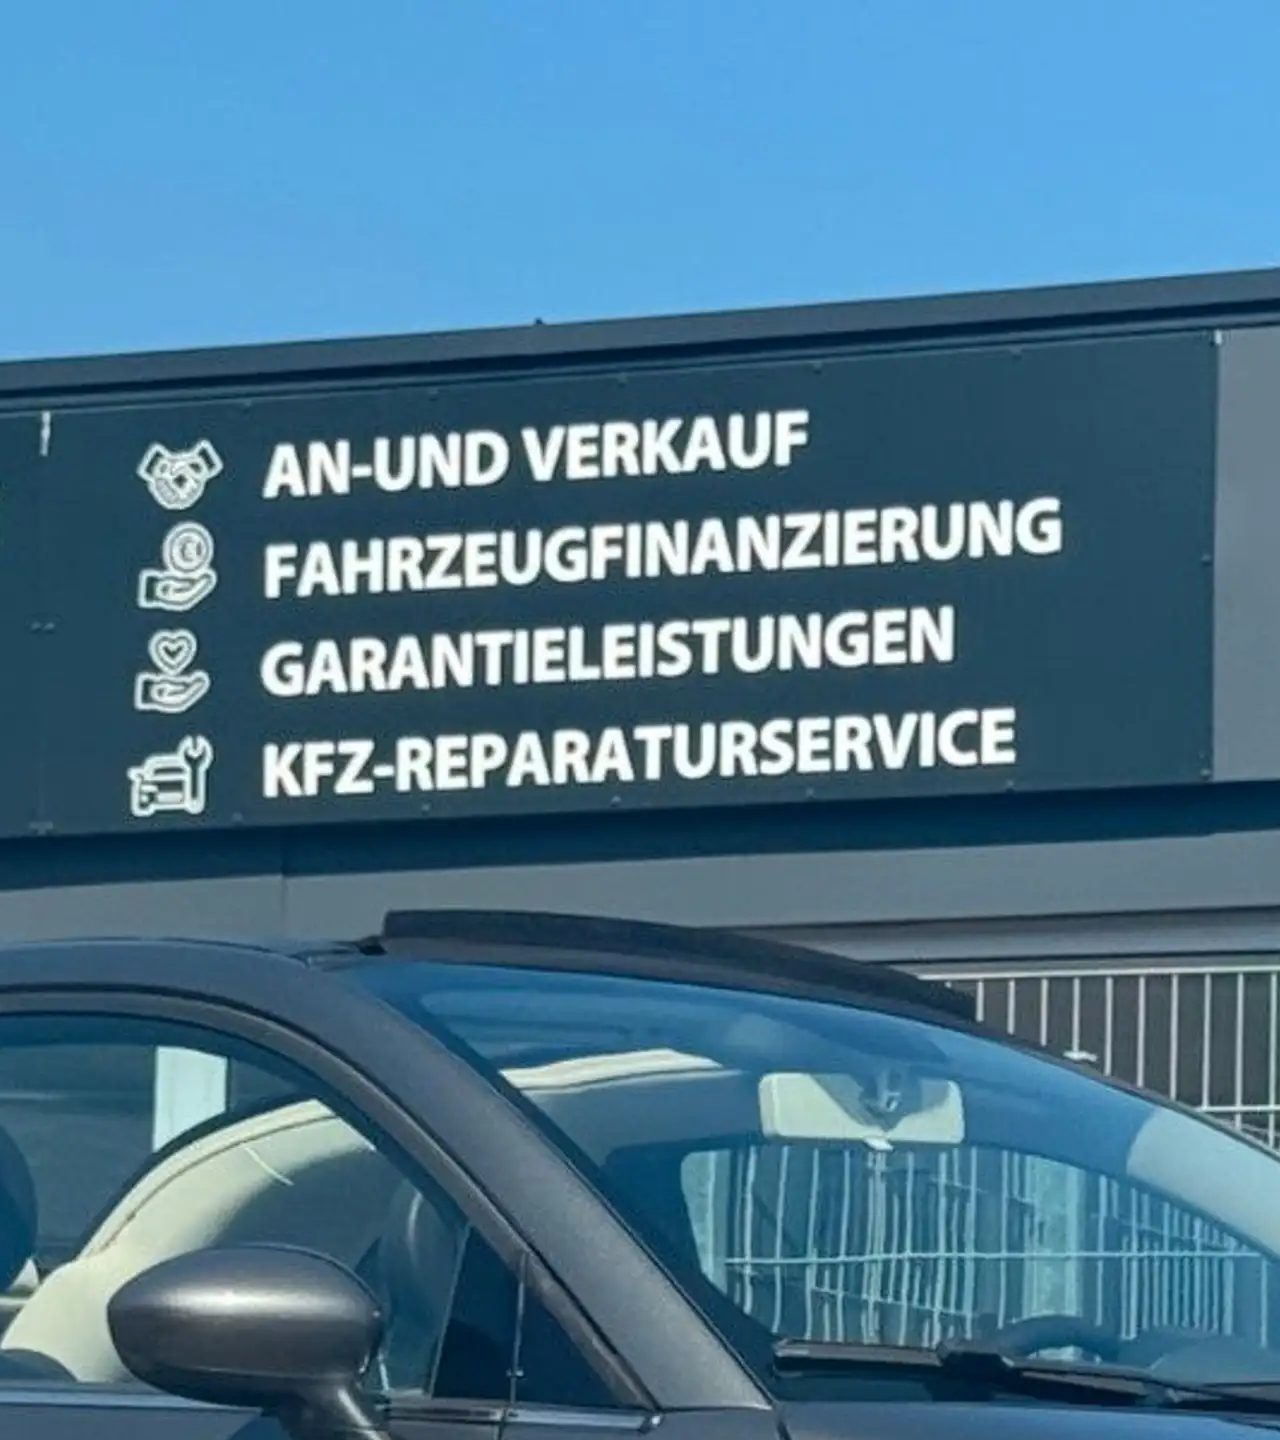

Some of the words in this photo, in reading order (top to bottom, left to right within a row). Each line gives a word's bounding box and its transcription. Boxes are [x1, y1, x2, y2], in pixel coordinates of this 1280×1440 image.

[263, 431, 509, 498] AN-UND
[521, 410, 809, 481] VERKAUF
[263, 489, 1062, 598] FAHRZEUGFINANZIERUNG
[261, 606, 954, 697] GARANTIELEISTUNGEN
[263, 707, 1016, 798] KFZ-REPARATURSERVICE
